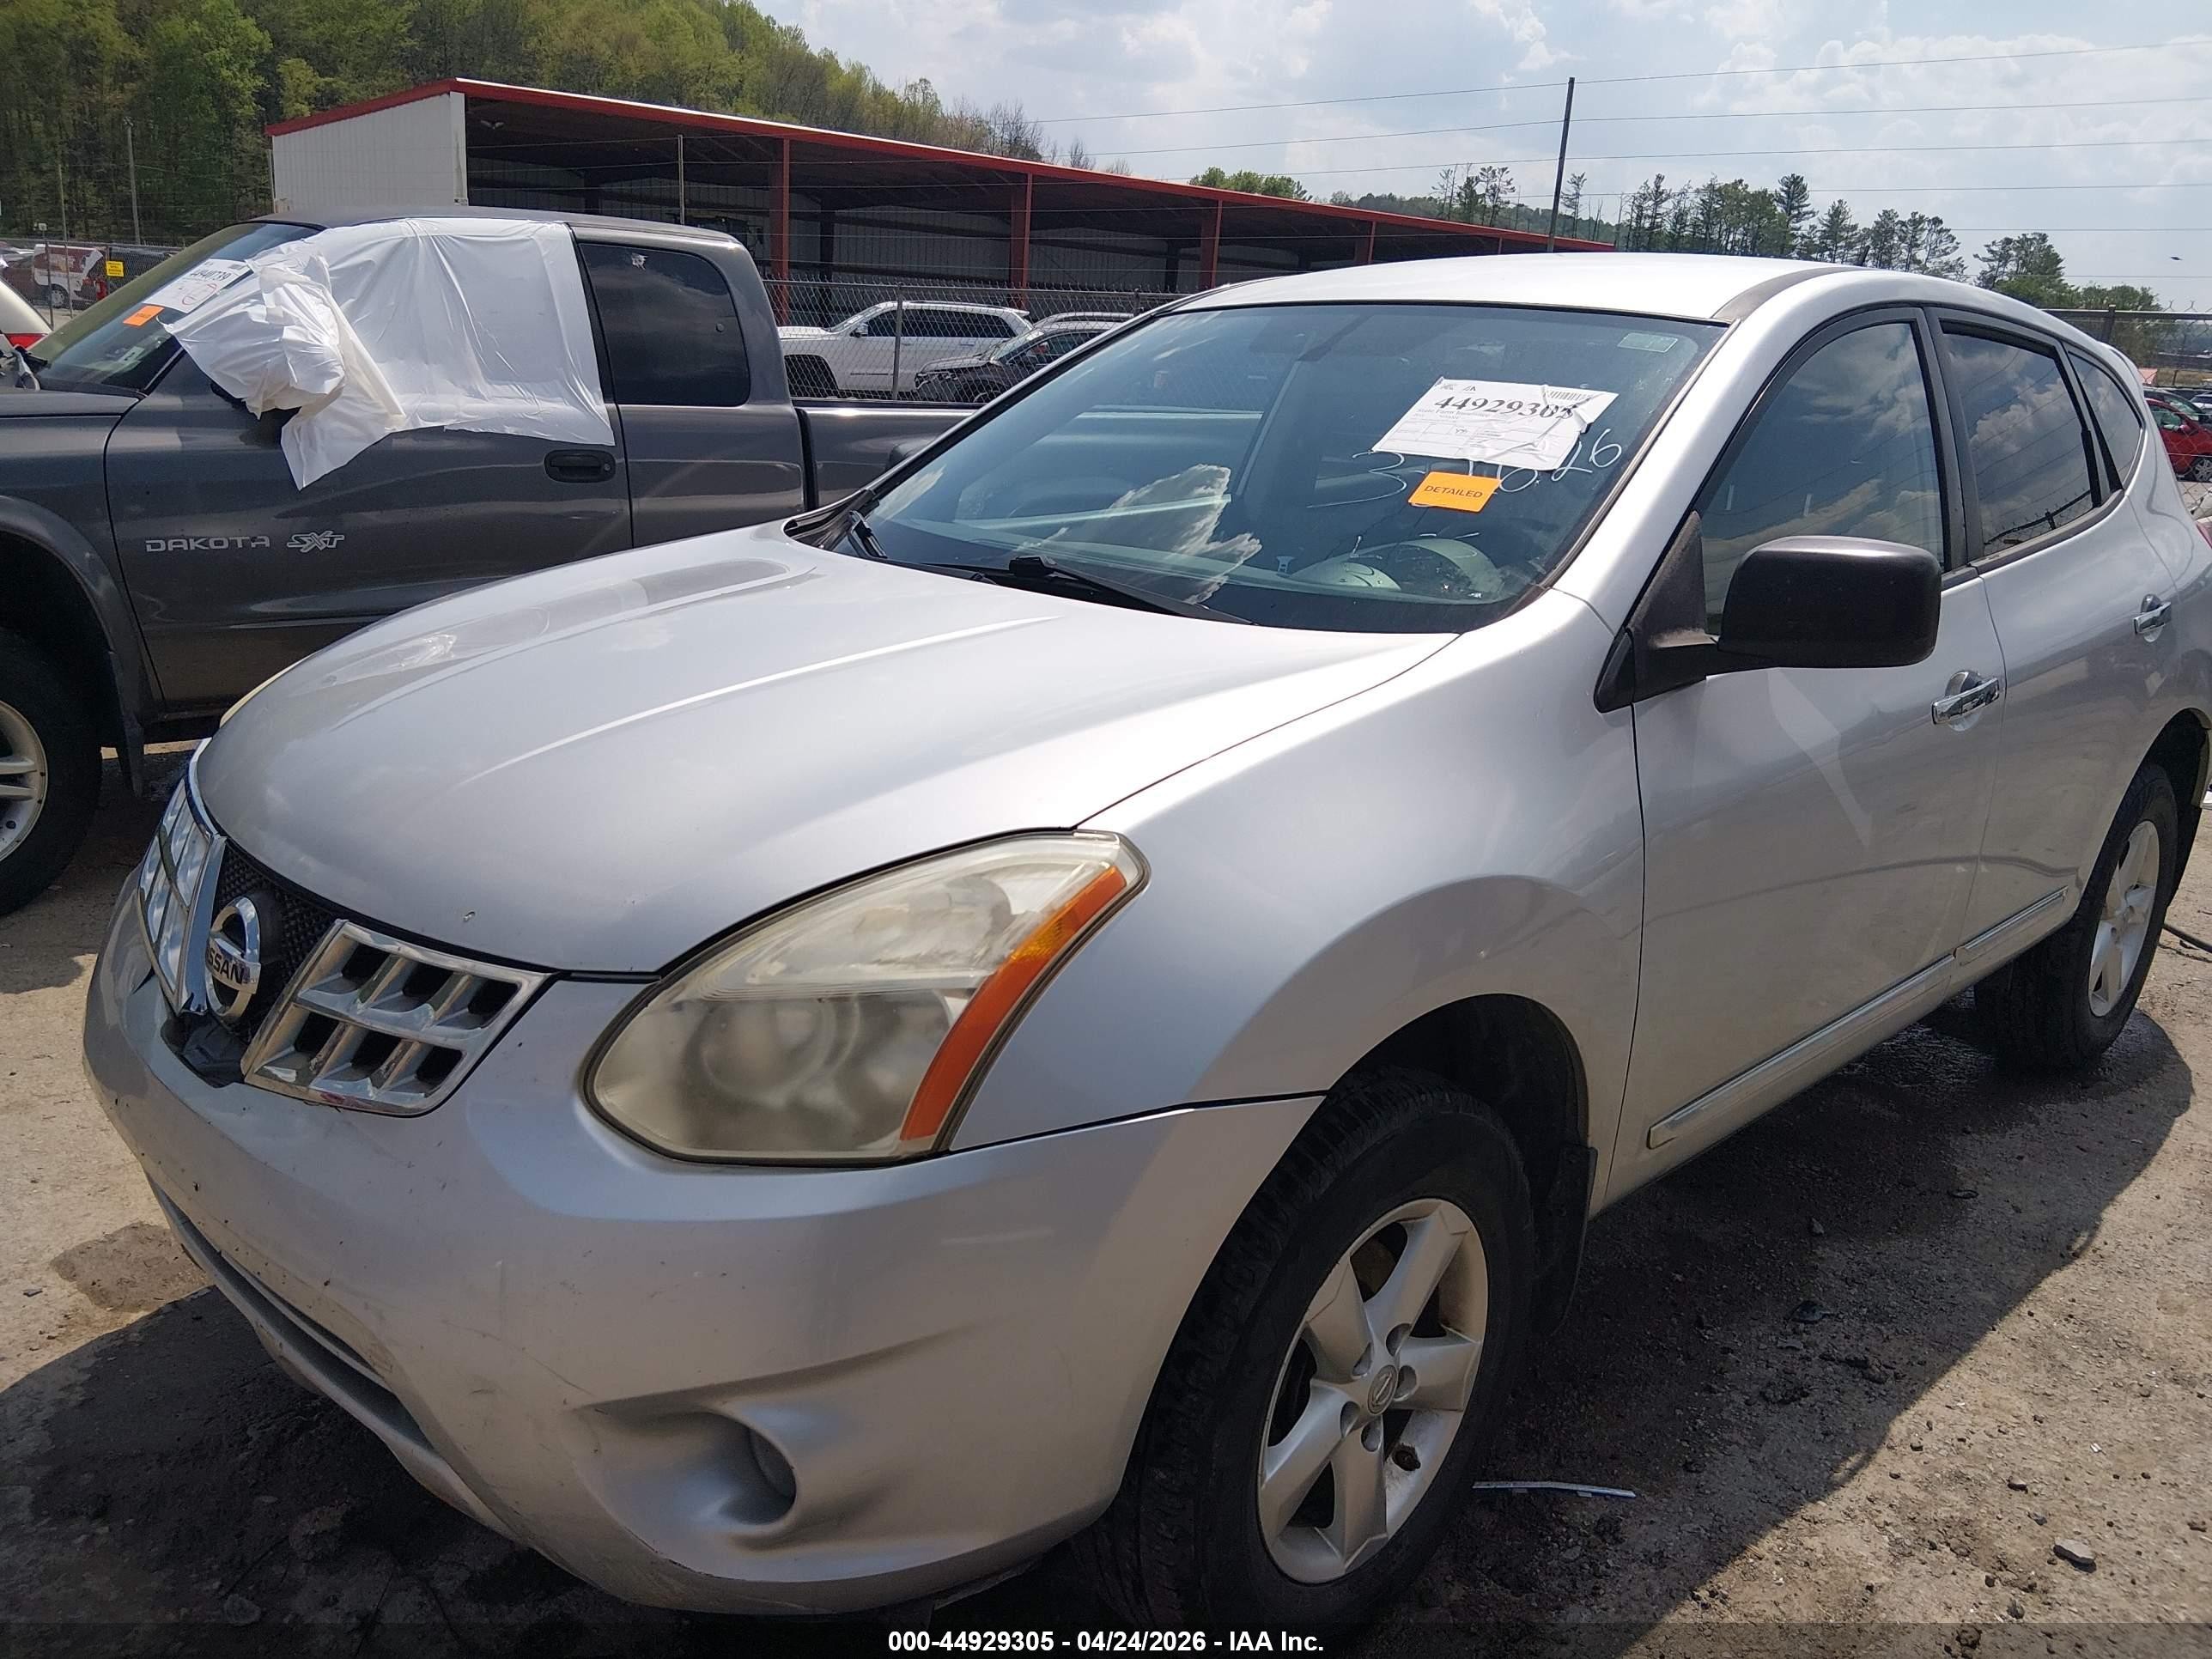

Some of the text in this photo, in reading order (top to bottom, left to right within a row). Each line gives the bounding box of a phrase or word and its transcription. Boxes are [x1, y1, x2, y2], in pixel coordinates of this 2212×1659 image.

[1425, 485, 1483, 499] DETAILED
[145, 530, 345, 552] DAKOTA SXT
